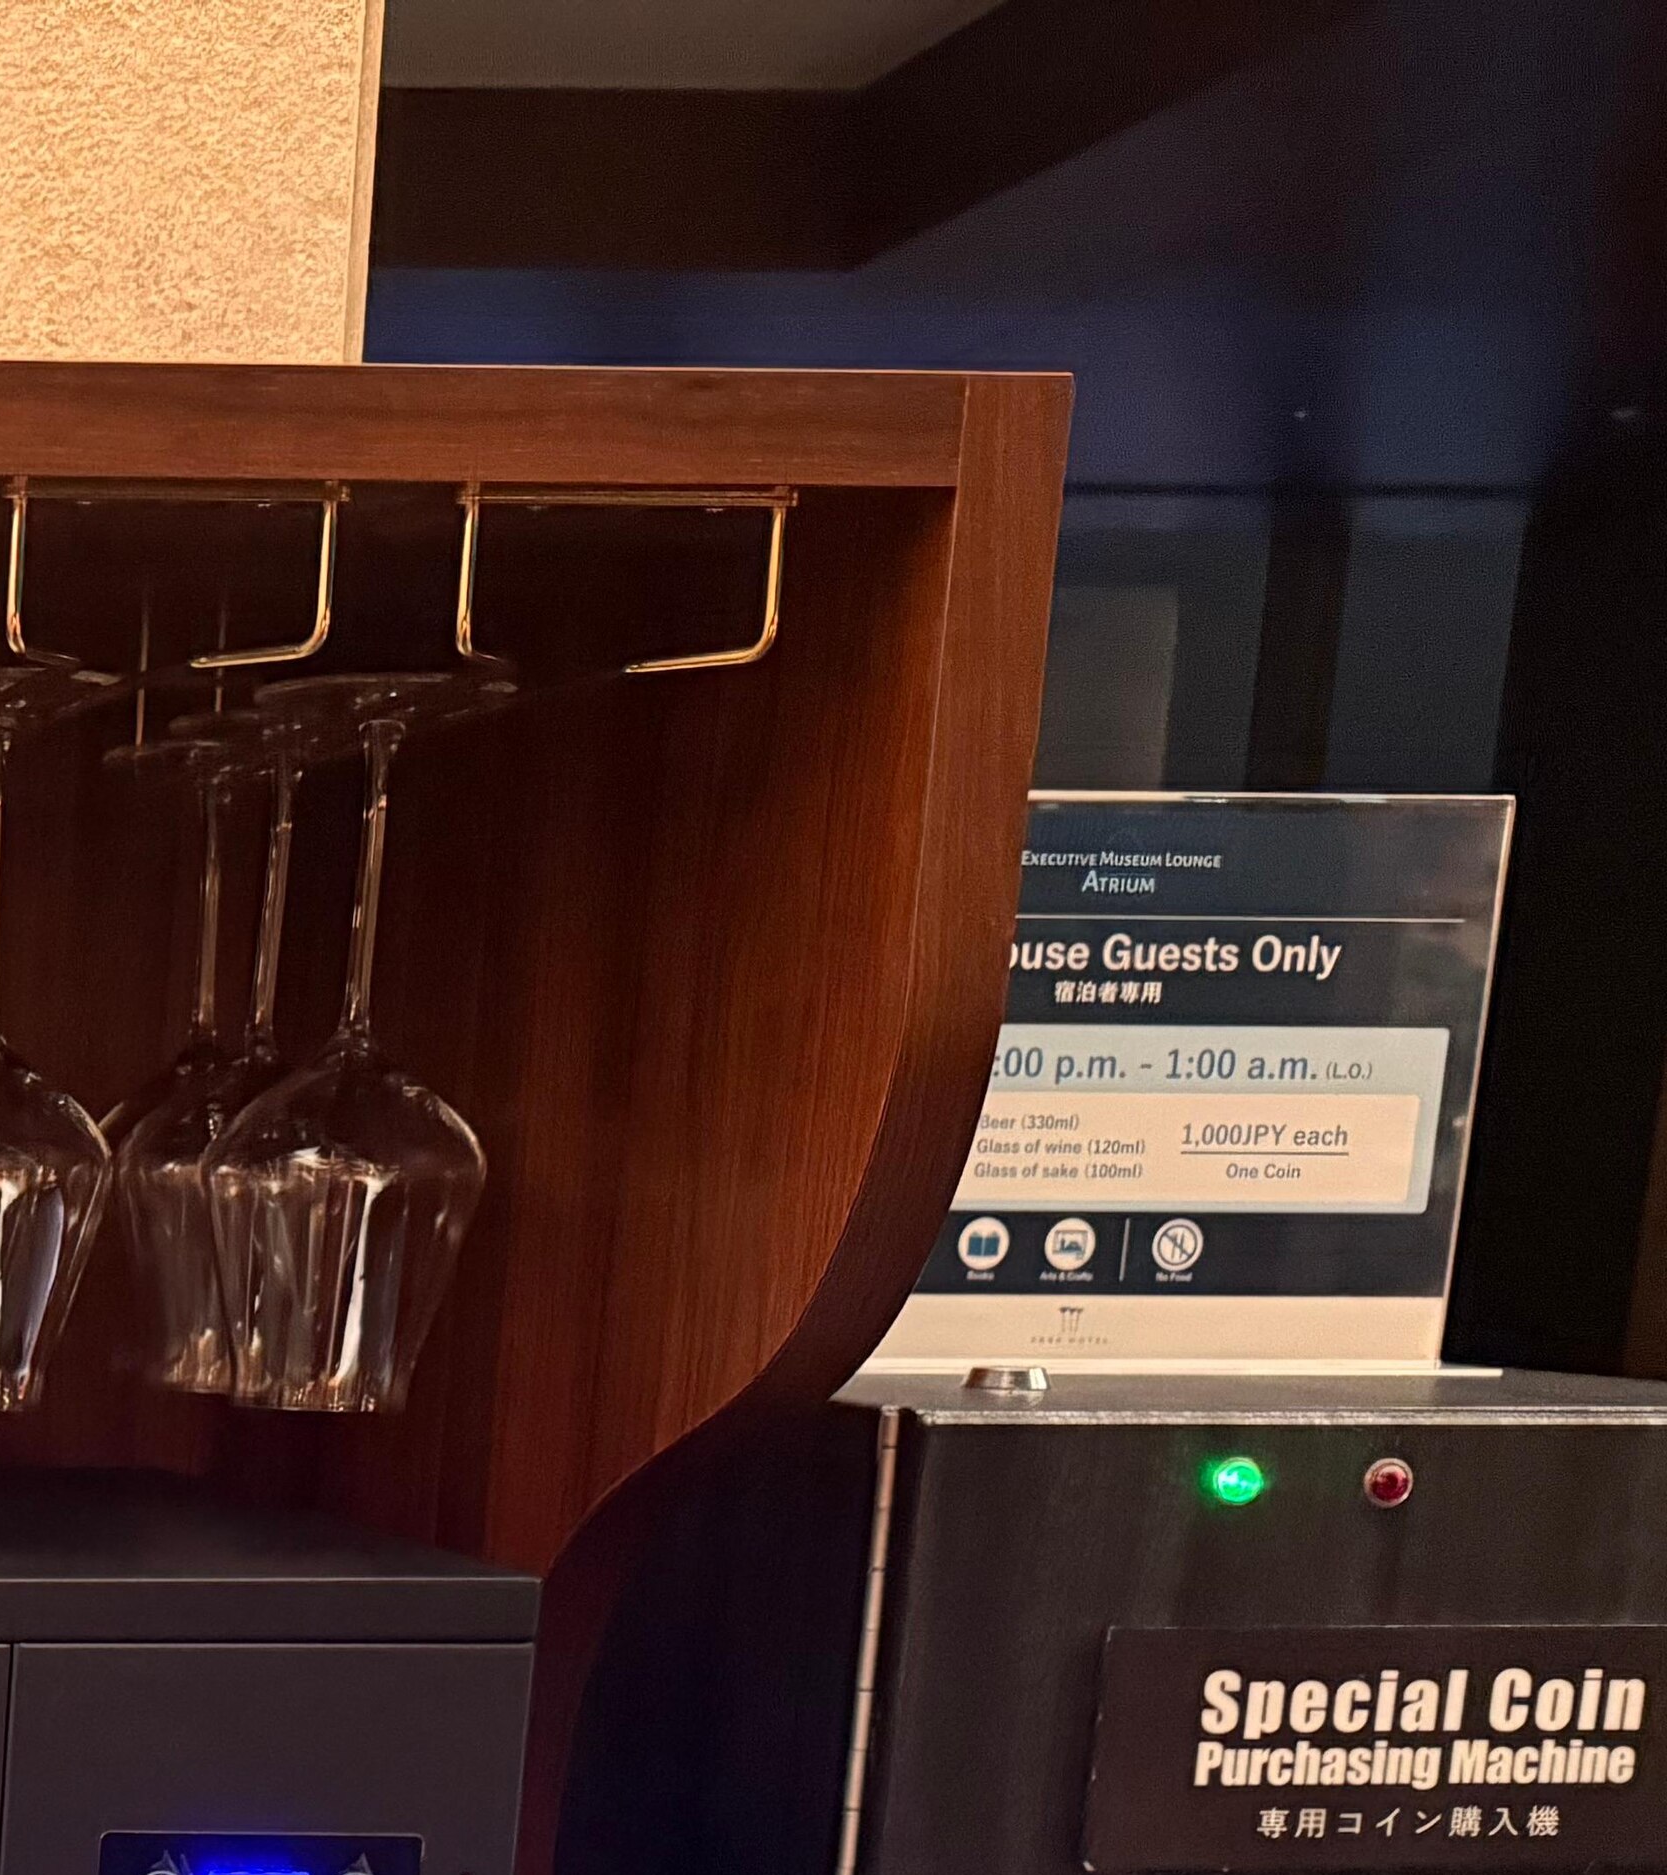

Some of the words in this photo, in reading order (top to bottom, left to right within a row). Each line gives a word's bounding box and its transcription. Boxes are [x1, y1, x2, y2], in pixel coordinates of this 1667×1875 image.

[1102, 933, 1240, 973] Guests
[1251, 935, 1343, 980] Only
[1055, 1050, 1126, 1084] p.m.
[1166, 1048, 1236, 1080] 1:00
[1247, 1052, 1317, 1080] a.m.
[1326, 1061, 1372, 1081] (L.O.)
[1021, 1114, 1080, 1131] (330ml)
[1181, 1123, 1286, 1147] 1,000JPY
[1293, 1124, 1348, 1147] each
[976, 1139, 1020, 1155] Glass
[1024, 1139, 1041, 1155] of
[1045, 1140, 1082, 1155] wine
[1087, 1139, 1146, 1156] (120ml)
[974, 1162, 1018, 1179] Glass
[1021, 1162, 1039, 1179] of
[1042, 1162, 1078, 1179] sake
[1226, 1164, 1258, 1179] One
[1264, 1163, 1301, 1180] Coin
[1200, 1669, 1469, 1740] Special
[1488, 1668, 1646, 1733] Coin
[1193, 1740, 1441, 1790] Purchasing
[1447, 1739, 1636, 1785] Machine
[1257, 1806, 1560, 1838] 専用コイン購入機
